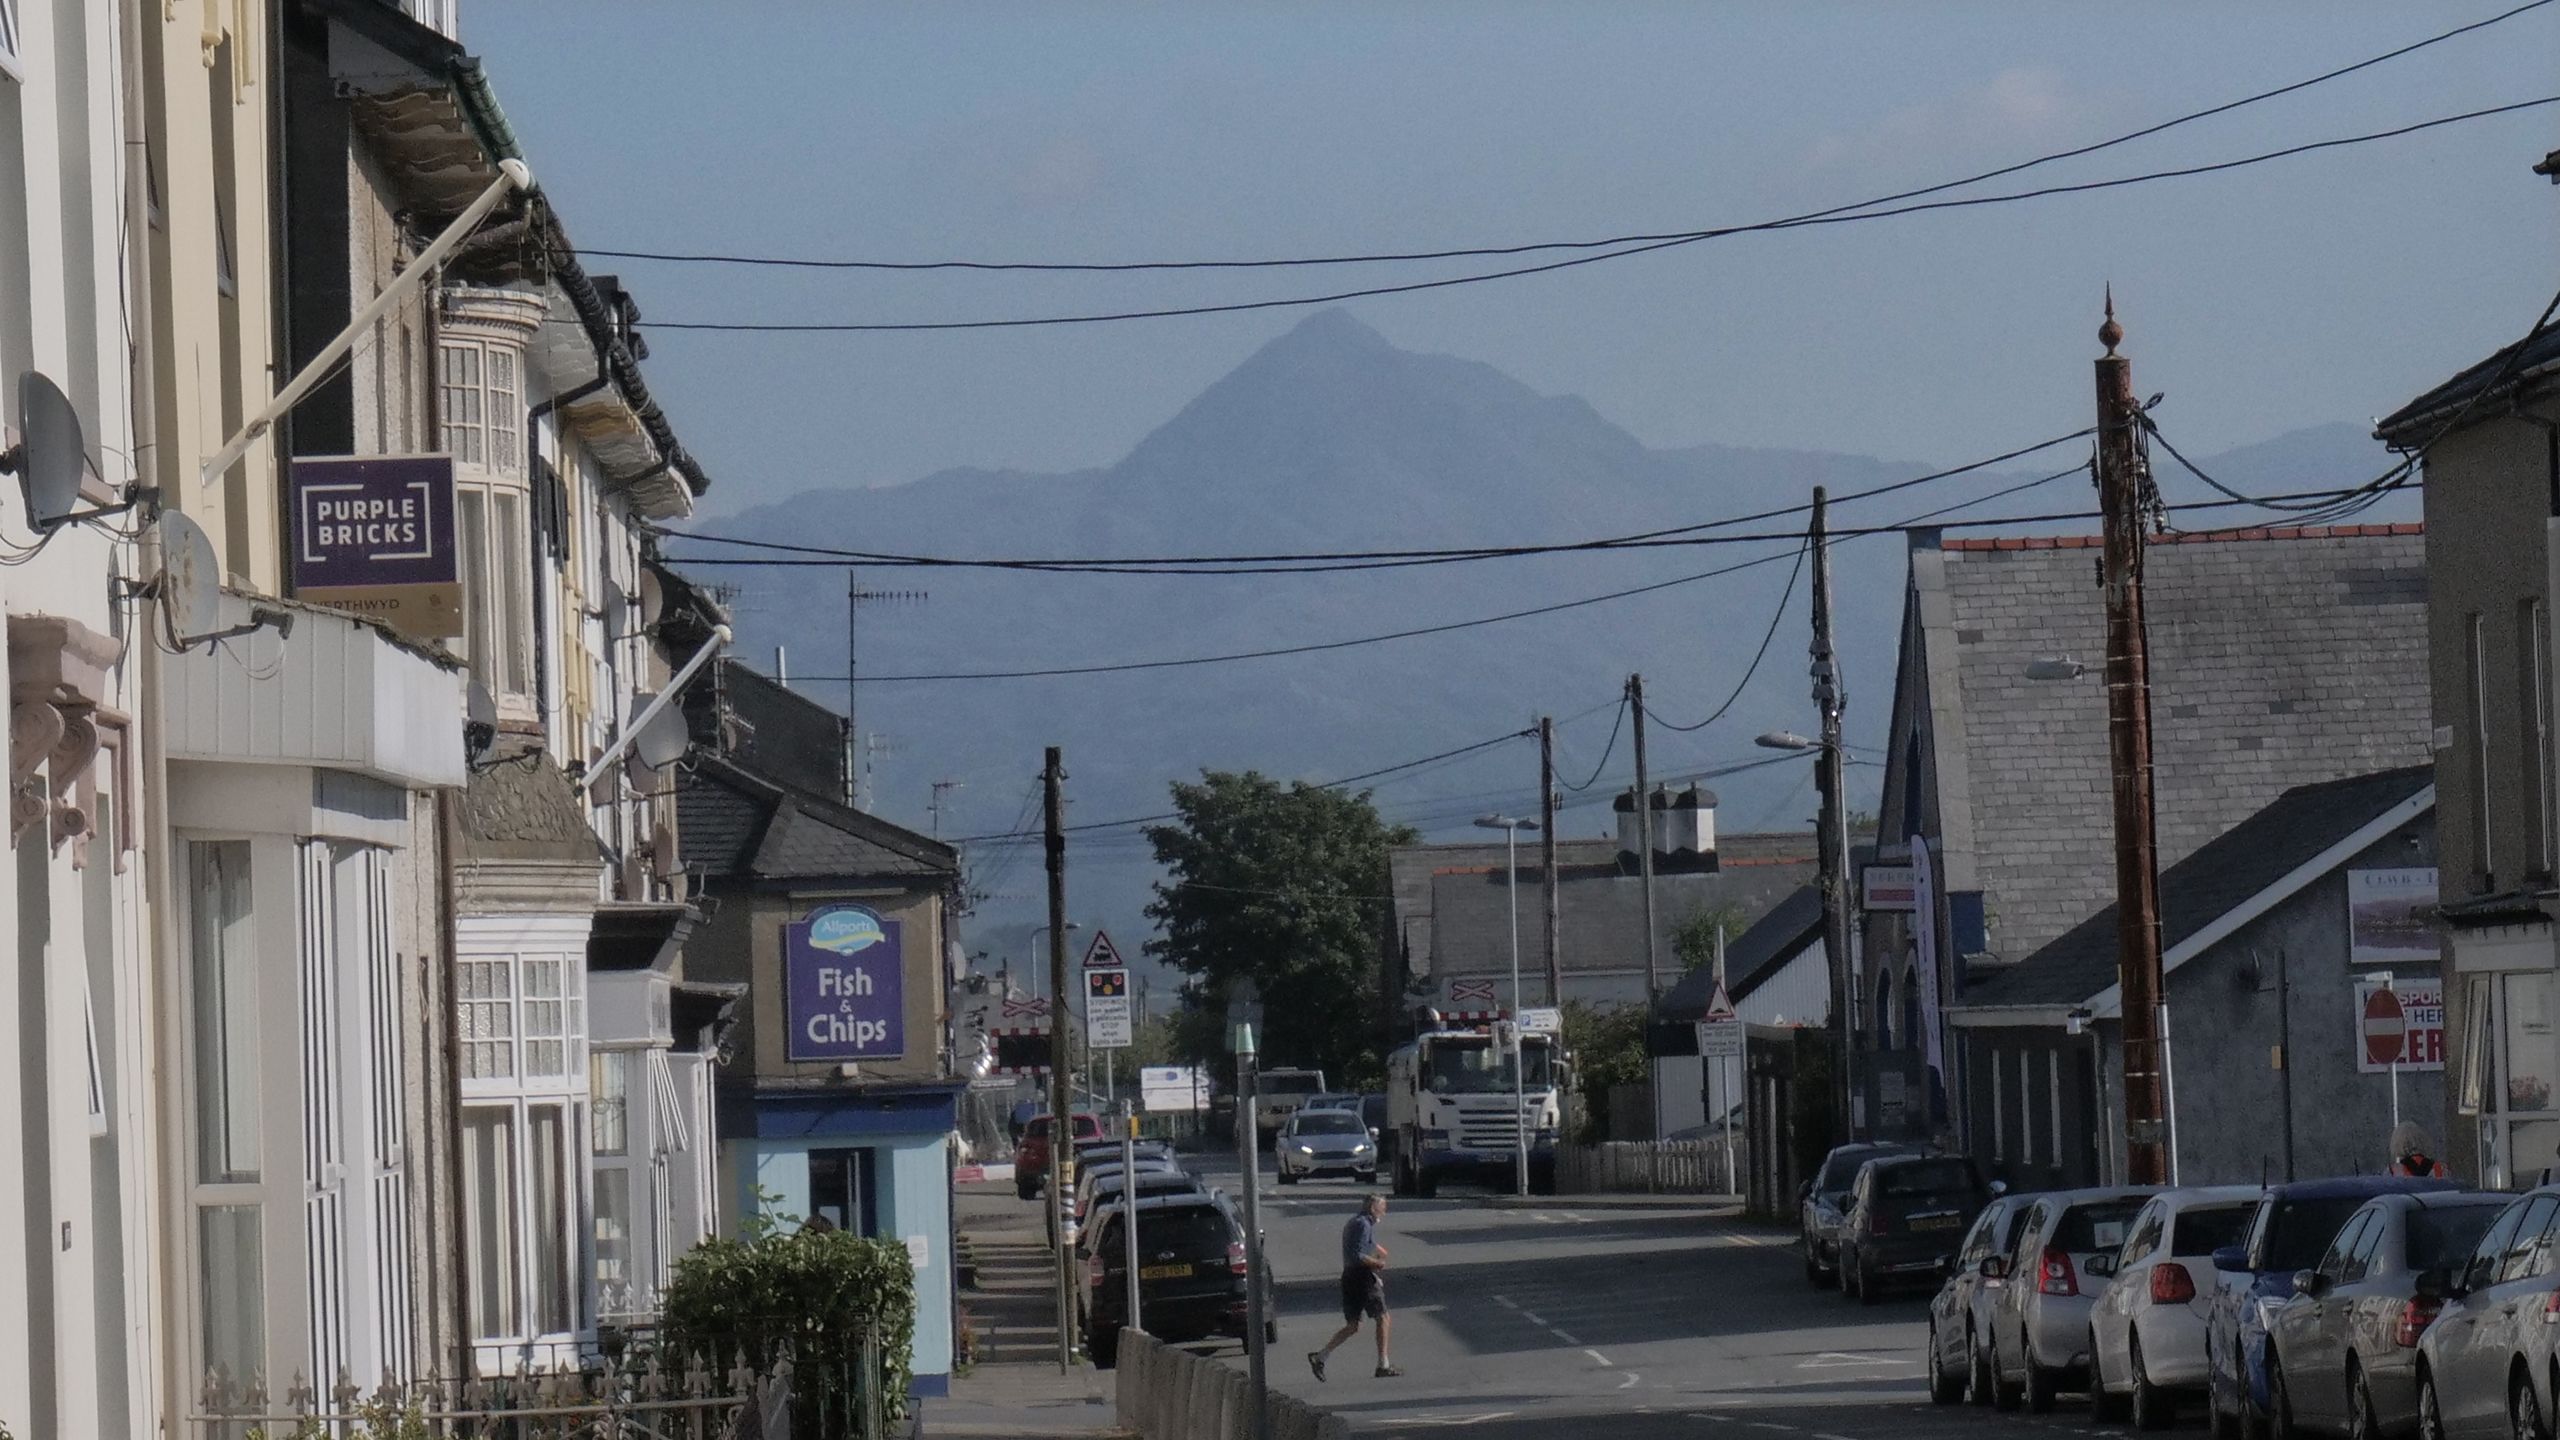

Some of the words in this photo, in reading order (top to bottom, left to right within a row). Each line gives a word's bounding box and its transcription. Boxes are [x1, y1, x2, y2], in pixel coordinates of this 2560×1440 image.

[317, 498, 416, 521] PURPLE
[318, 523, 416, 545] BRICKS
[821, 920, 871, 935] Allports
[818, 967, 873, 997] Fish
[839, 999, 852, 1013] &
[807, 1013, 887, 1049] Chips
